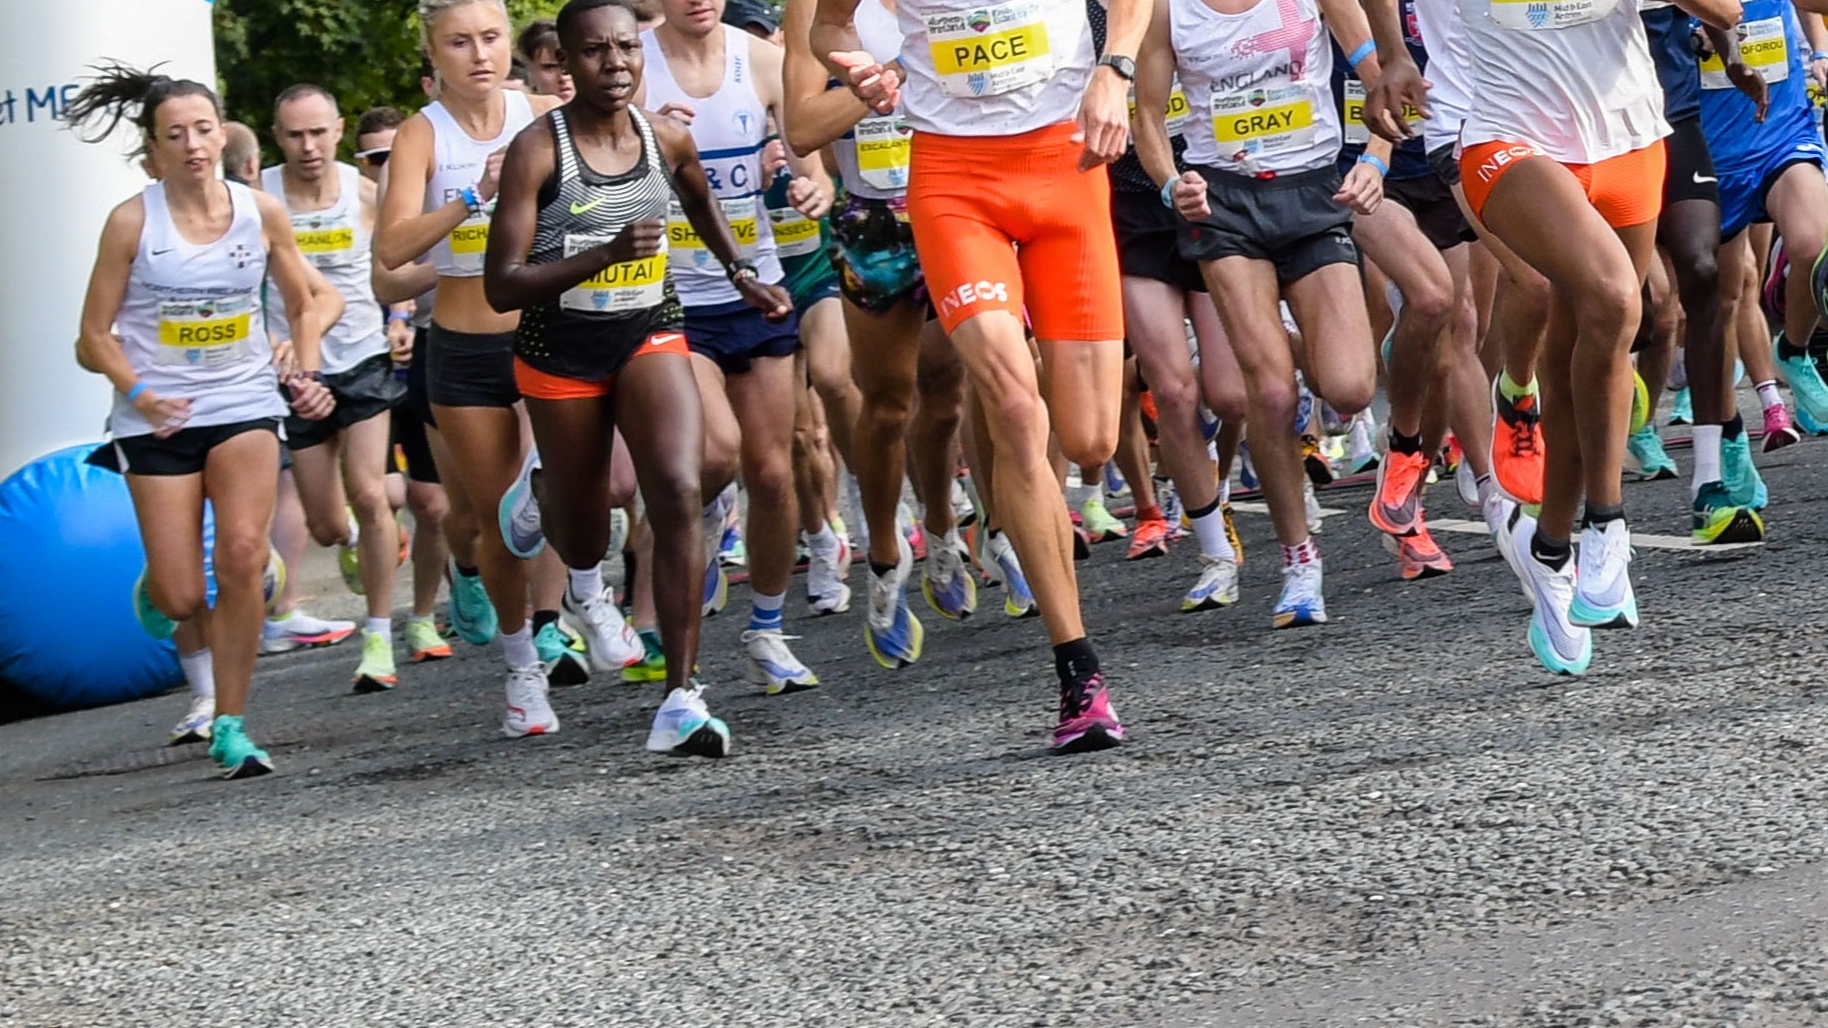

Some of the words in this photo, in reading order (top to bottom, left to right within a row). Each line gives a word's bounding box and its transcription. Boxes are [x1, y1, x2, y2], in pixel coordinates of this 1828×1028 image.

[954, 35, 1026, 67] PACE
[1210, 60, 1302, 93] ENGLAND
[1233, 110, 1293, 135] GRAY
[731, 166, 748, 188] C
[178, 323, 237, 343] ROSS
